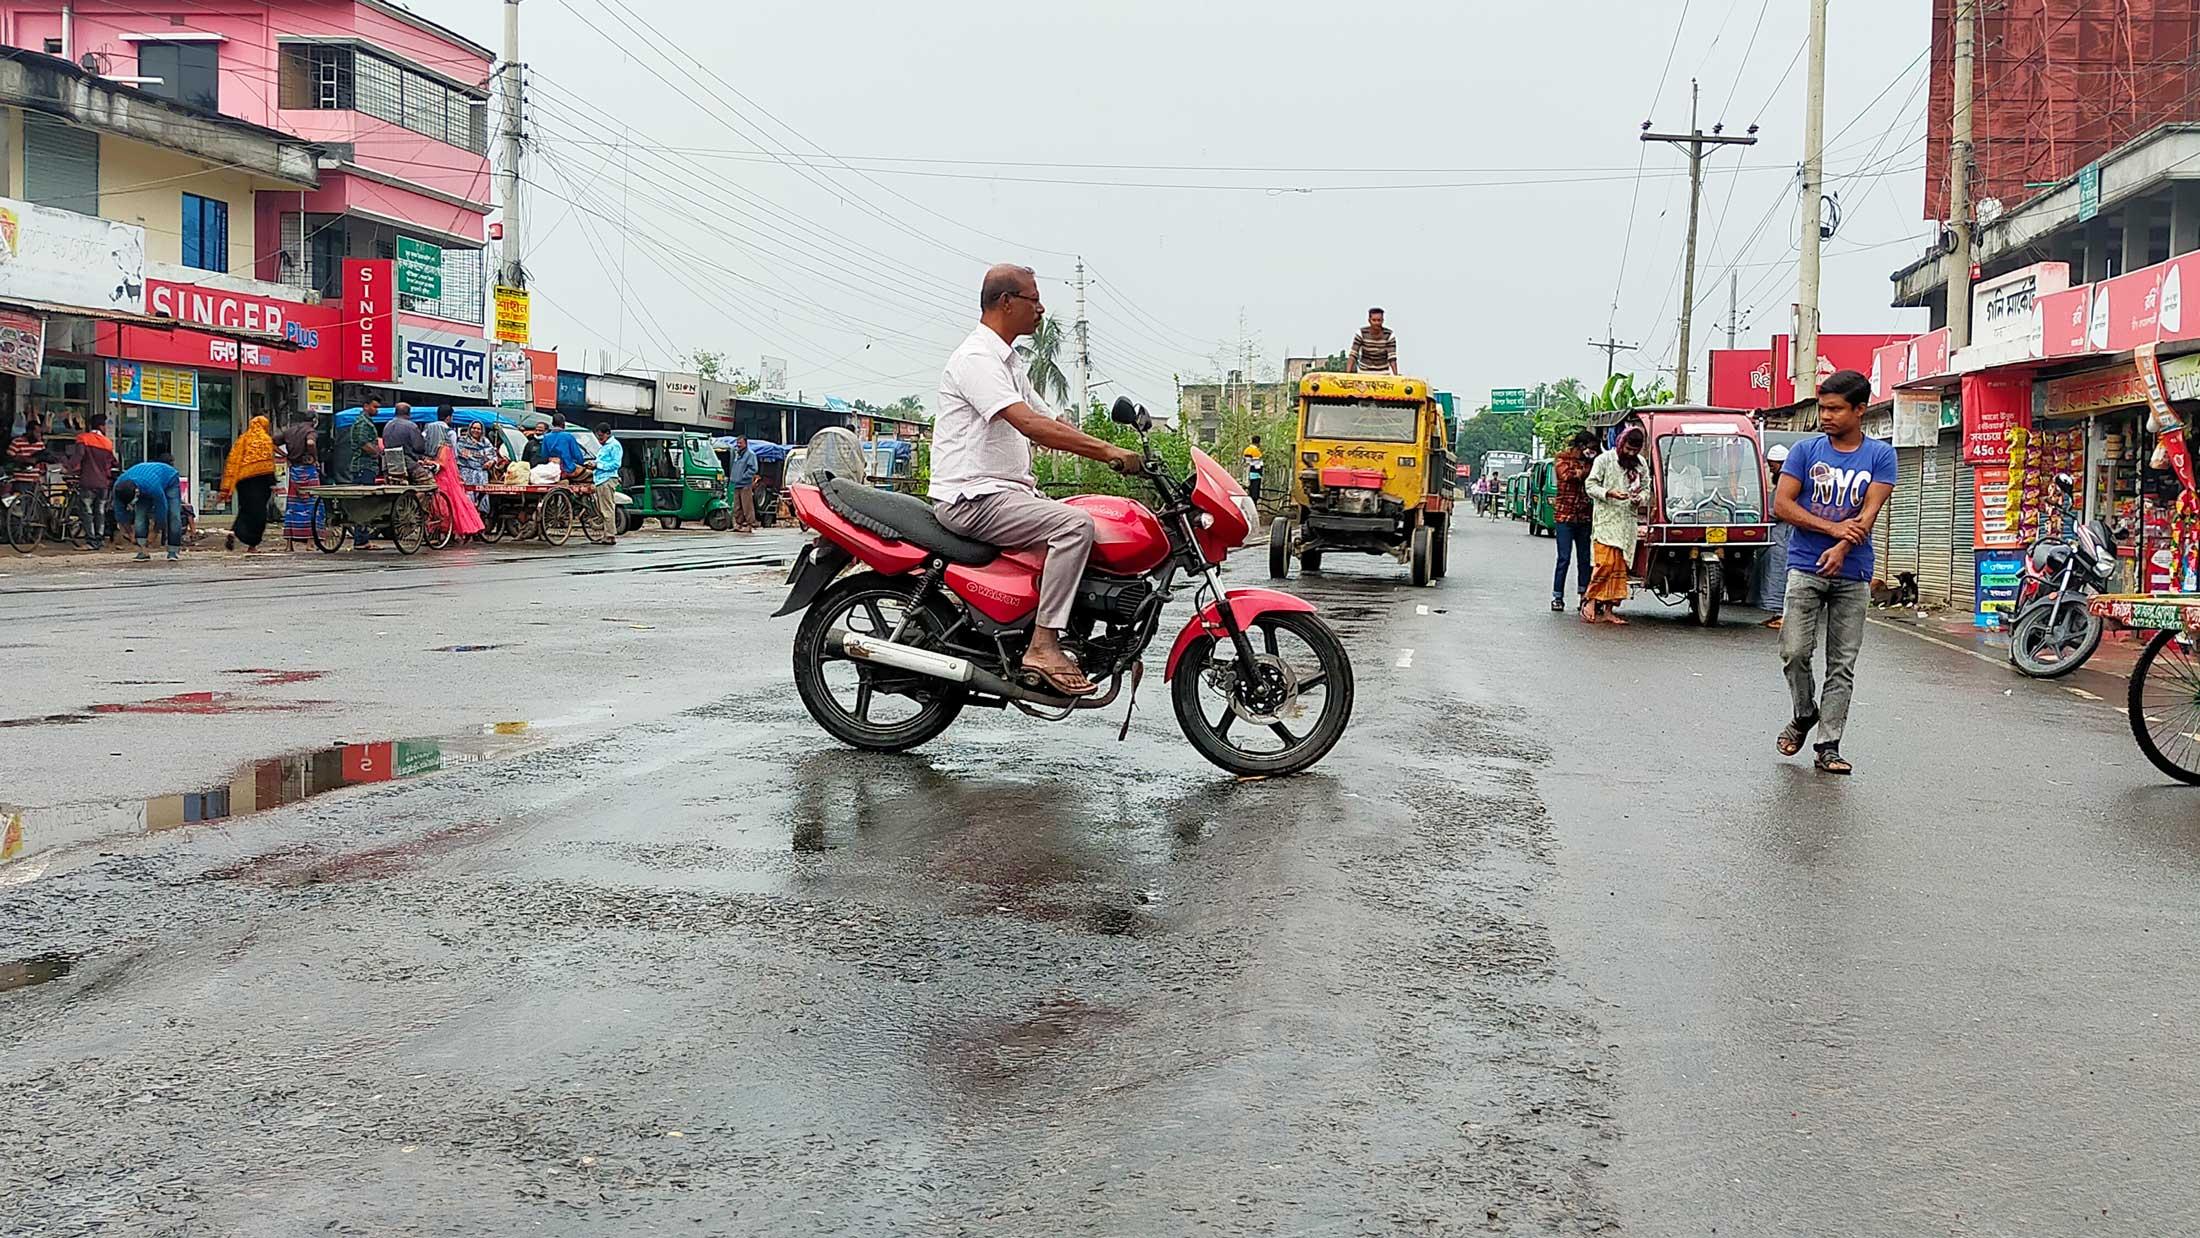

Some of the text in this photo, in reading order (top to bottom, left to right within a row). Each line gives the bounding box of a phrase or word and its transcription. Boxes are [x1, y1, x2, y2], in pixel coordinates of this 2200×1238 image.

[152, 286, 283, 334] SINGER
[360, 267, 375, 364] SINGER
[285, 321, 319, 348] Plus
[406, 340, 486, 384] মার্সেল
[666, 382, 697, 392] VISION
[1811, 467, 1872, 507] NYC
[978, 585, 1020, 607] WALTON
